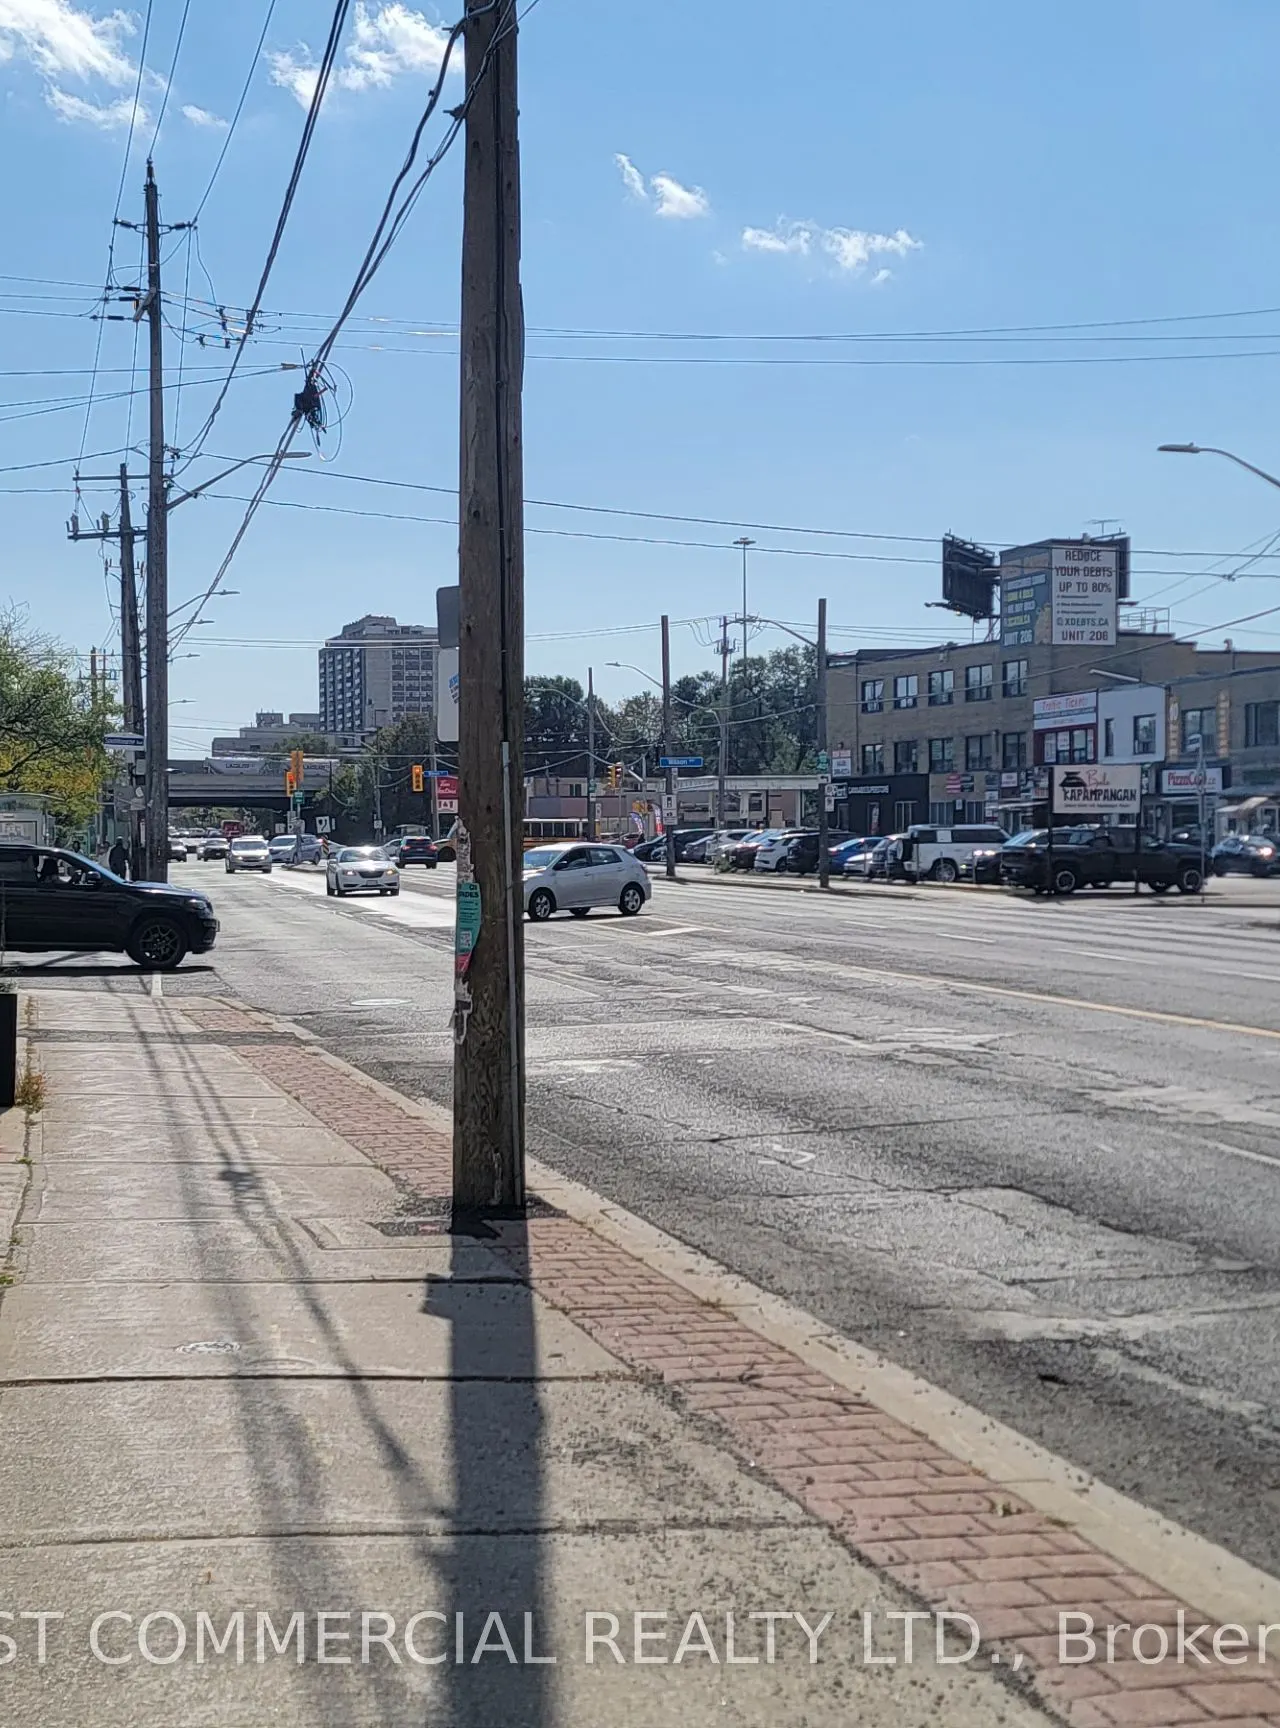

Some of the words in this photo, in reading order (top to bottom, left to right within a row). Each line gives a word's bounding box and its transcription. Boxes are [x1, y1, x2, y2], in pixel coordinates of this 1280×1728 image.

[1065, 550, 1102, 561] REDUCE
[1055, 566, 1080, 577] YOUR
[1083, 566, 1113, 577] DEBTS
[1059, 582, 1073, 593] UP
[1076, 582, 1088, 592] TO
[1091, 582, 1112, 593] 80%
[1061, 630, 1085, 642] UNIT
[1064, 788, 1137, 801] KAPAMPANGAN
